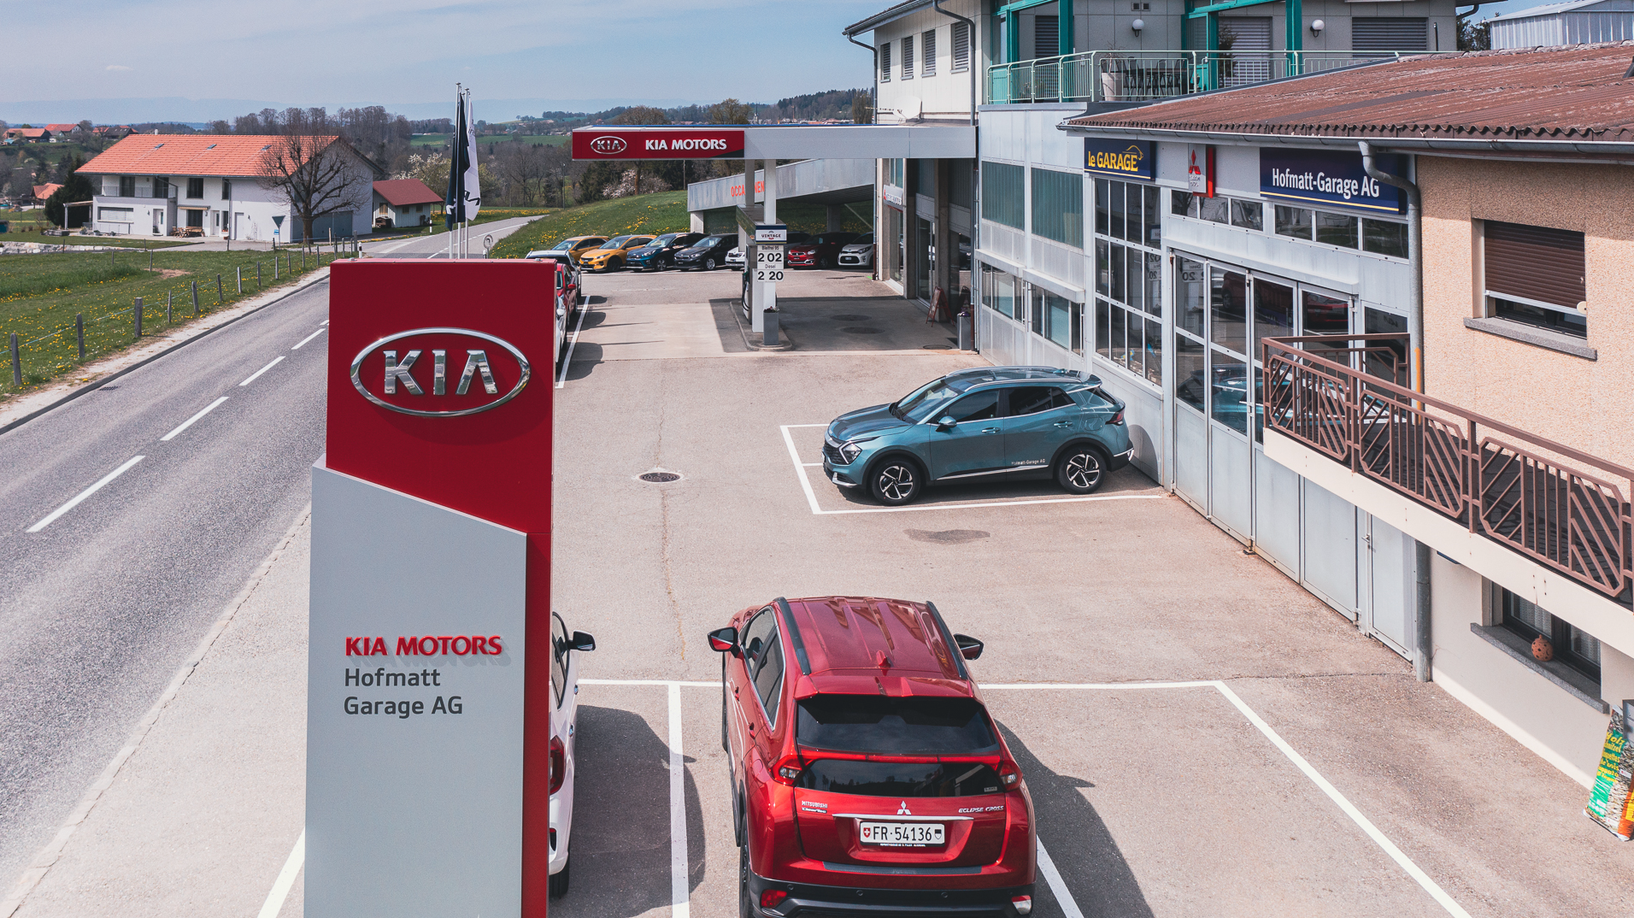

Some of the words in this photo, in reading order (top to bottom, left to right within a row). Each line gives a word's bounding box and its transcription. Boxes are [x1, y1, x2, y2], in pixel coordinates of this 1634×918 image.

[596, 140, 621, 150] KIA
[645, 139, 668, 150] KIA
[671, 139, 727, 150] MOTORS
[1088, 151, 1096, 167] le
[1096, 152, 1139, 172] GARAGE
[1272, 168, 1358, 199] Hofmatt-Garage
[1361, 176, 1380, 198] AG
[383, 350, 499, 395] KIA
[345, 636, 388, 656] KIA
[395, 635, 502, 656] MOTORS
[345, 668, 441, 687] Hofmatt
[344, 696, 424, 719] Garage
[431, 696, 463, 715] AG
